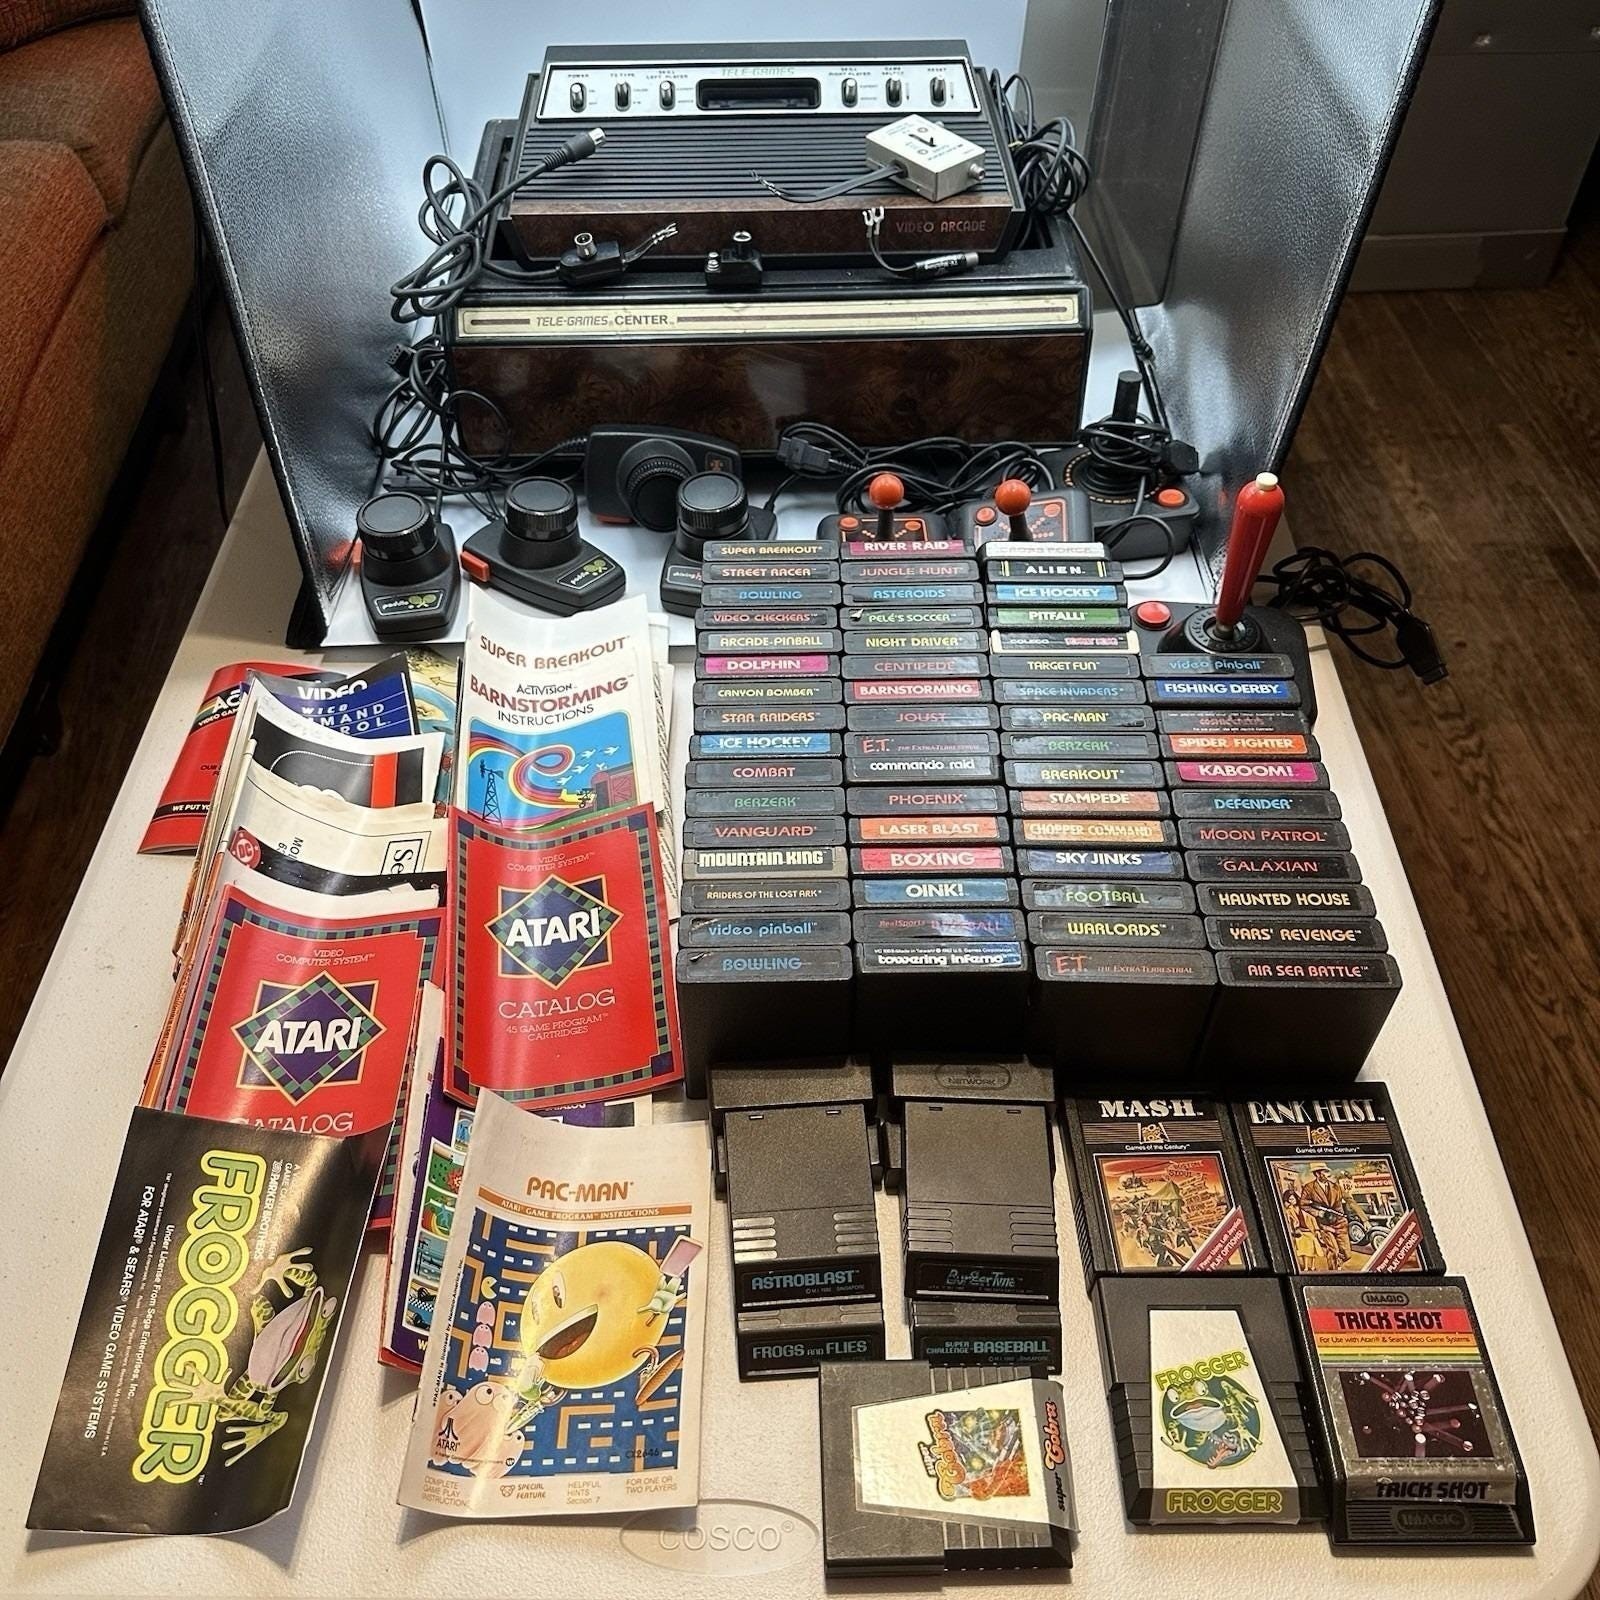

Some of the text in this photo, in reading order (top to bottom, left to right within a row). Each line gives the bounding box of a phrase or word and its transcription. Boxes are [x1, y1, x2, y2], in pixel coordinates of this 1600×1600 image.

[895, 220, 987, 233] VIDEO ARCADE
[536, 315, 668, 327] TELE-GAMES CENTER
[721, 546, 818, 555] SUPER BREAKOUT
[864, 541, 949, 550] RIVER RAID
[721, 568, 811, 577] STREET RACER
[859, 567, 958, 576] JUNGLE HUNT
[1025, 566, 1082, 574] ALIEN
[739, 591, 802, 600] BOWLING
[873, 589, 946, 599] ASTEROIDS
[1015, 588, 1100, 597] ICE HOCKEY
[713, 613, 811, 622] VIDEO CHECKERS
[720, 636, 822, 647] ARCADE PINBALL
[866, 637, 959, 647] NIGHT DRIVER
[480, 635, 625, 669] SUPER BREAKOUT
[727, 660, 800, 670] DOLPHIN
[874, 662, 954, 671] CENTIPEDE
[1027, 660, 1096, 670] TARGET FUN
[470, 674, 629, 713] BARNSTORMING
[718, 688, 814, 698] CANYON BOMBER
[860, 684, 972, 695] BARNSTORMING
[1019, 687, 1119, 696] SPACE INVADERS
[1165, 684, 1279, 694] FISHING DERBY
[498, 704, 595, 726] INSTRUCTIONS
[722, 712, 815, 723] STAR RAIDERS
[896, 713, 946, 722] JOUST
[1042, 712, 1106, 722] PAC-MAN
[719, 736, 811, 748] ICE HOCKEY
[1048, 741, 1109, 751] BERZERK
[1178, 738, 1294, 748] SPIDER FIGHTER
[870, 758, 975, 771] commando raid
[733, 767, 795, 778] COMBAT
[1041, 769, 1119, 780] BREAKOUT
[1199, 765, 1294, 777] KABOOM!
[734, 798, 796, 807] BERZERK
[889, 794, 963, 805] PHOENIX
[1049, 793, 1130, 804] STAMPEDE
[1214, 798, 1290, 809] DEFENDER
[715, 826, 814, 838] VANGUARD
[879, 823, 980, 834] LASER BLAST
[1201, 829, 1325, 842] MOON PATROL
[507, 855, 590, 872] COMPUTER SYSTEM
[890, 852, 975, 867] BOXING
[1056, 853, 1142, 865] SKY JINKS
[1223, 860, 1318, 872] GALAXIAN
[706, 889, 818, 899] RAIDERS OF THE LOST ARK
[906, 883, 963, 898] OINK!
[1066, 890, 1149, 904] FOOTBALL
[1218, 893, 1350, 906] HAUNTED HOUSE
[505, 908, 600, 947] ATARI
[708, 922, 813, 937] video pinball
[1068, 924, 1160, 936] WARLORDS
[1230, 928, 1355, 942] YARS' REVENGE
[313, 949, 344, 957] VIDEO
[276, 954, 368, 967] COMPUTER SYSTEM
[722, 959, 803, 972] BOWLING
[878, 955, 947, 965] towering
[1248, 966, 1361, 978] AIR SEA BATTLE
[499, 988, 616, 1019] CATALOG
[506, 1016, 602, 1034] 45 GAME PROGRAM
[253, 1017, 362, 1054] ATARI
[528, 1026, 588, 1041] CARTRIDGES
[1248, 1100, 1376, 1123] BANK HEIST
[526, 1177, 629, 1202] PAC-MAN
[140, 1185, 155, 1208] FOR
[501, 1200, 659, 1219] ATARI GAME PROGRAM INSTRUCTIONS
[129, 1246, 140, 1254] &
[119, 1256, 139, 1296] SEARS
[751, 1270, 855, 1290] ASTROBLAST
[1366, 1295, 1405, 1304] IMAGIC
[109, 1304, 127, 1340] VIDEO
[132, 1149, 267, 1484] FROGGER
[1335, 1312, 1442, 1330] TRICK SHOT
[1446, 1336, 1470, 1344] Systems
[753, 1345, 805, 1360] FROGS
[826, 1340, 868, 1355] FLIES
[973, 1341, 1050, 1353] BASEBALL
[99, 1343, 117, 1378] GAME
[1155, 1351, 1249, 1391] FROGGER
[85, 1382, 108, 1439] SYSTEMS
[424, 1476, 458, 1490] COMPLETE
[517, 1483, 544, 1491] SPECIAL
[568, 1482, 601, 1490] HELPFUL
[626, 1476, 673, 1486] FOR ONE OR
[424, 1485, 460, 1498] GAME PLAY
[516, 1491, 546, 1499] FEATURE
[567, 1489, 590, 1497] HINTS
[626, 1484, 677, 1494] TWO PLAYERS
[1376, 1481, 1490, 1499] TRICK SHOT
[1167, 1490, 1282, 1514] FROGGER
[1402, 1512, 1461, 1526] IMAGIC
[659, 1524, 782, 1552] COSCO
